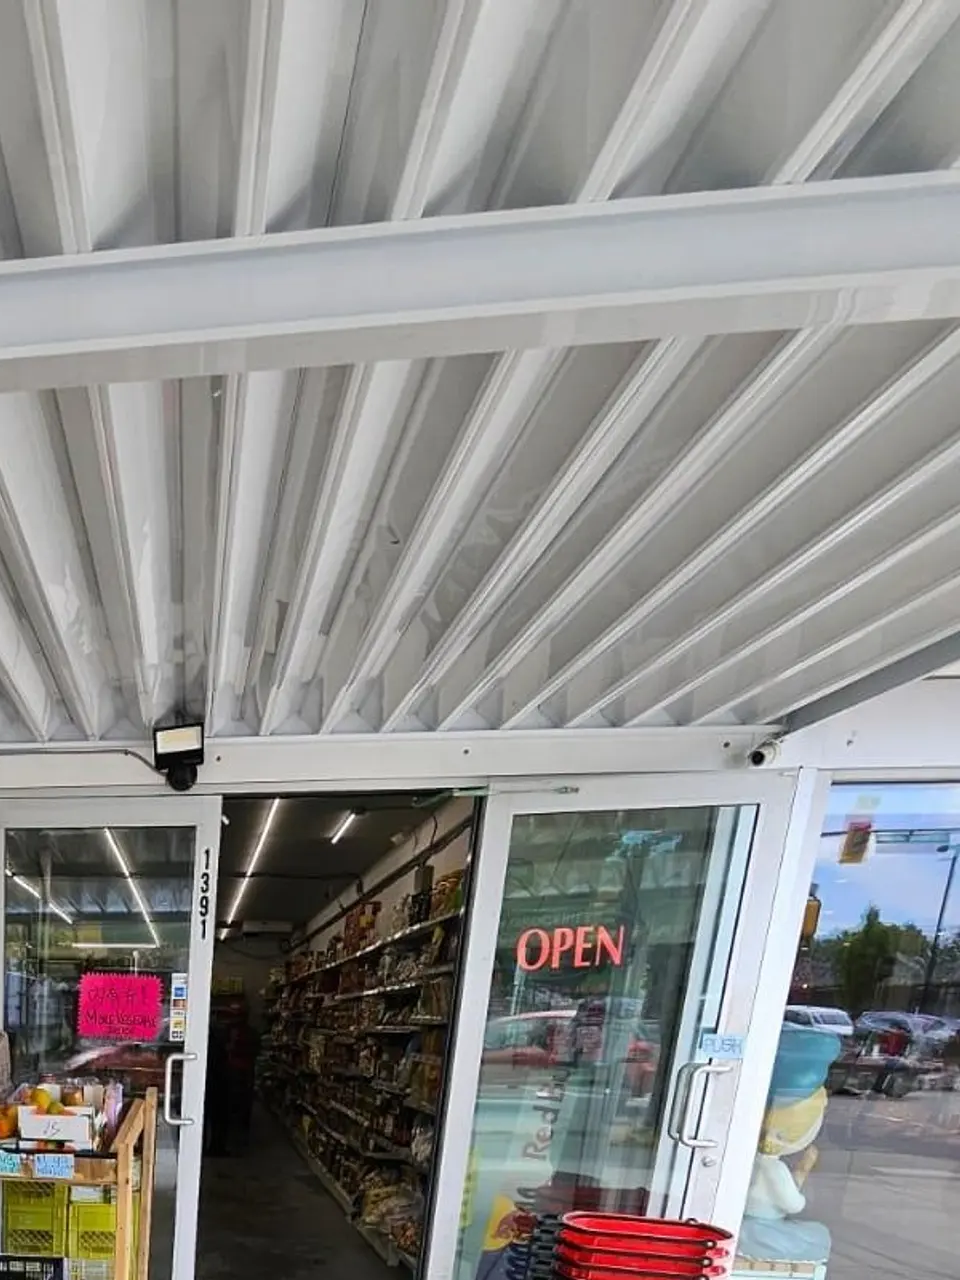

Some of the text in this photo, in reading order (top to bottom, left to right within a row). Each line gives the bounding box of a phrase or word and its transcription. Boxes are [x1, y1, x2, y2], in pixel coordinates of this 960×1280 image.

[200, 848, 210, 939] 1391
[516, 924, 625, 971] OPEN
[703, 1037, 742, 1054] PUSH
